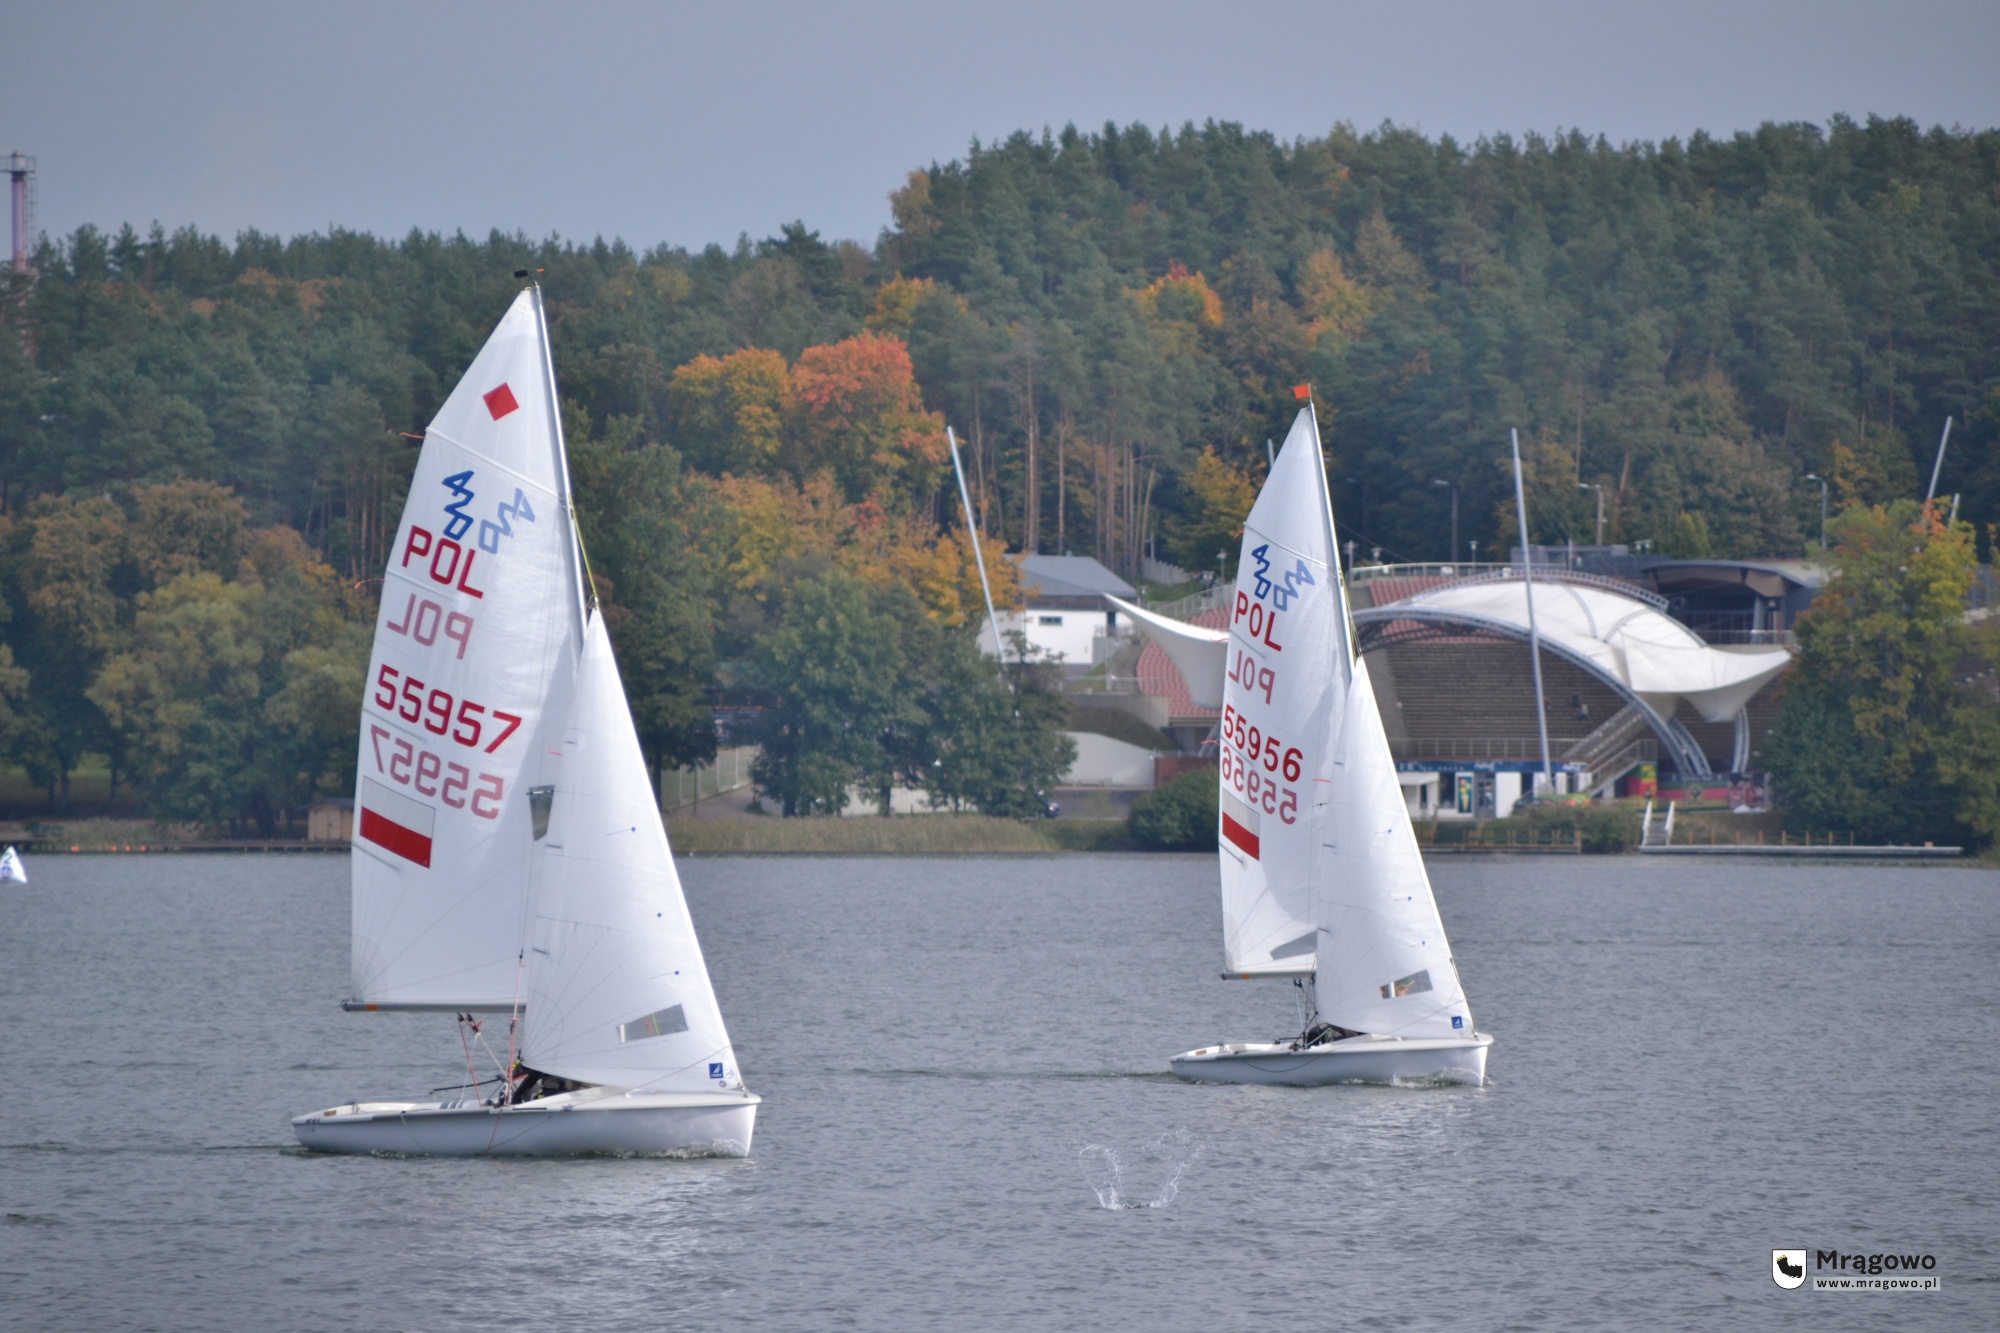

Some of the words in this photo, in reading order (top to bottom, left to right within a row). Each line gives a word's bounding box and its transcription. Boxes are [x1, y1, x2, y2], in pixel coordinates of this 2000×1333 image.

[442, 470, 474, 541] 420
[402, 525, 483, 599] POL
[1251, 544, 1272, 600] 420
[1235, 591, 1282, 652] POL
[375, 664, 522, 754] 55957
[1223, 703, 1303, 782] 55956
